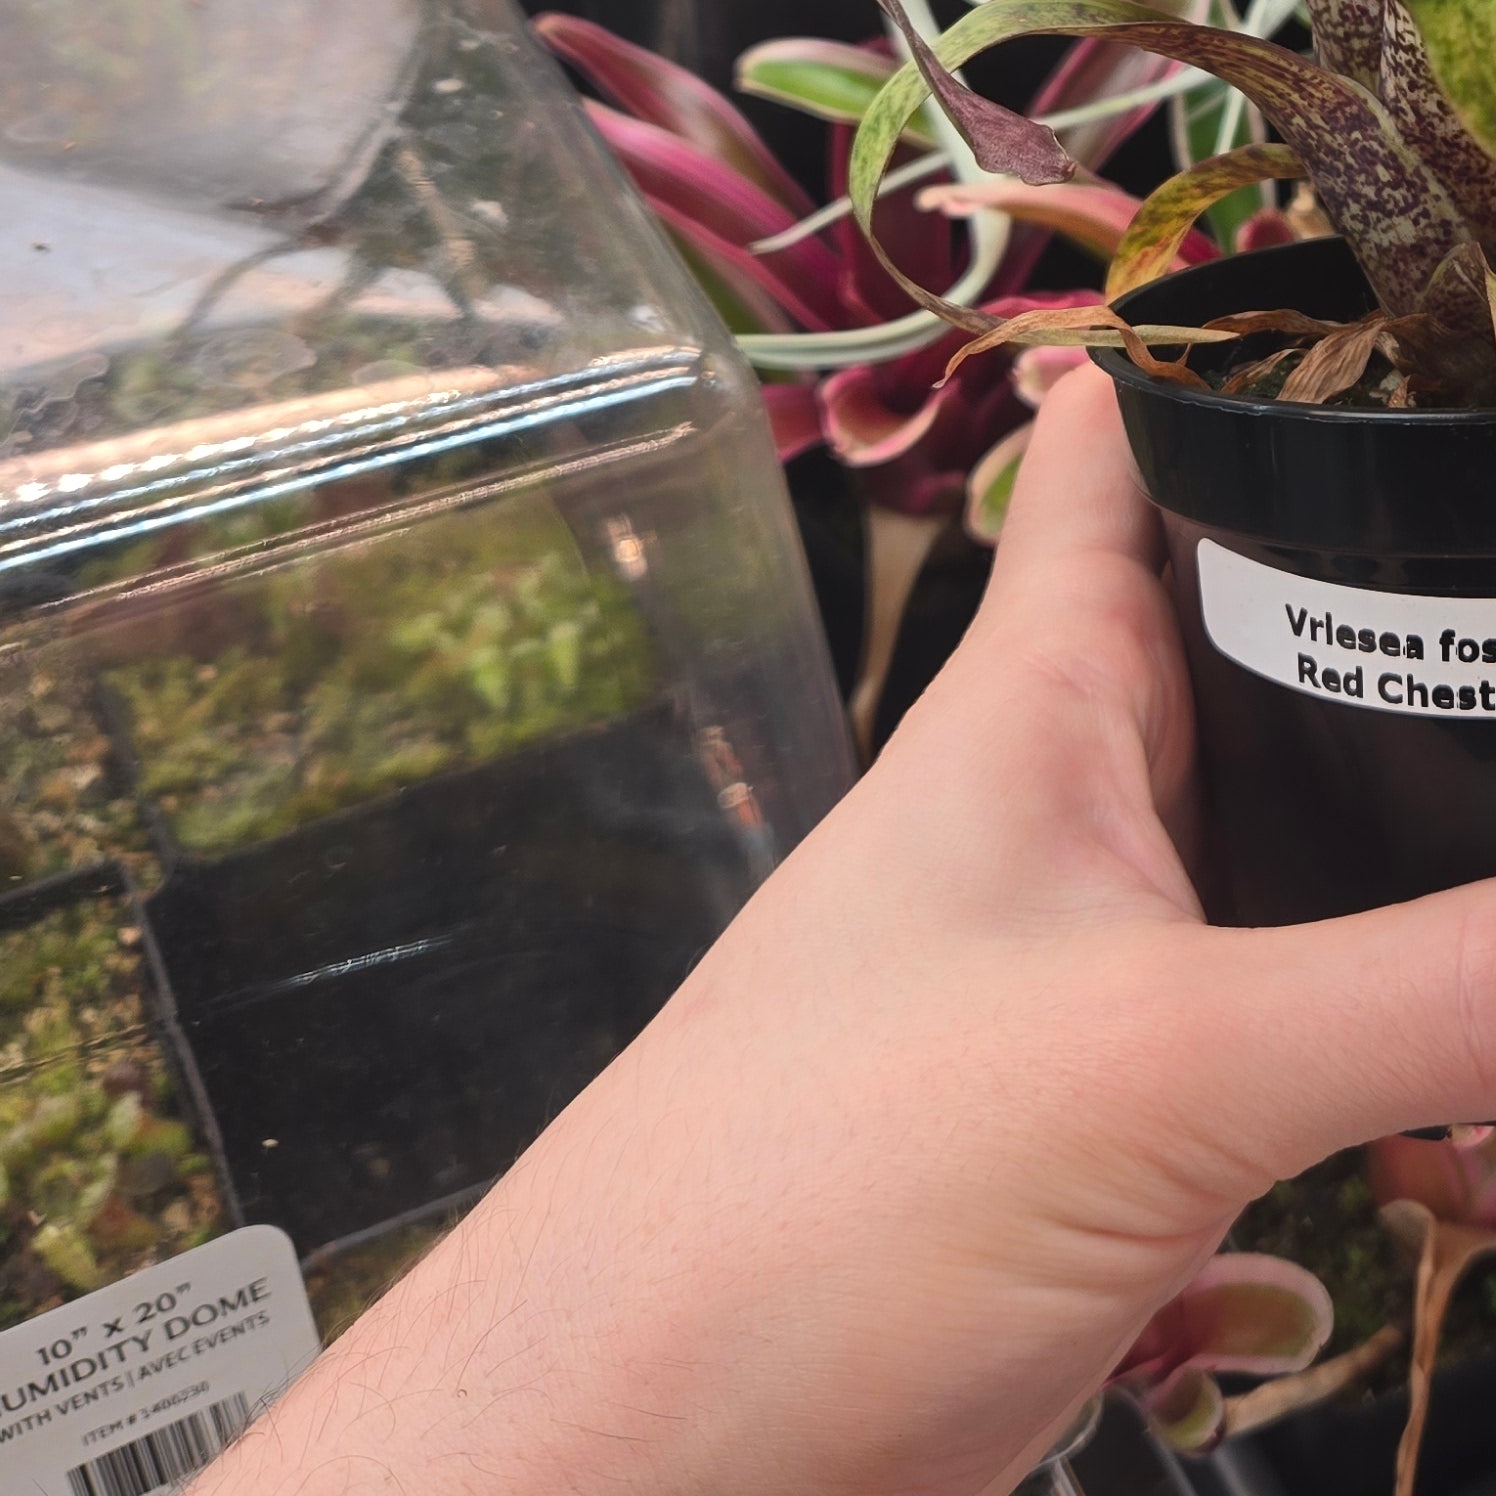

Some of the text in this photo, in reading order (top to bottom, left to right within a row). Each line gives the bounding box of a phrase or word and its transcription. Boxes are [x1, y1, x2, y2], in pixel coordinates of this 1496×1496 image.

[1297, 651, 1364, 699] Red
[0, 1276, 273, 1418] UMIDITY DOME
[55, 1379, 125, 1416] VENTS
[138, 1346, 190, 1381] AVEC
[82, 1414, 124, 1447] ITEM
